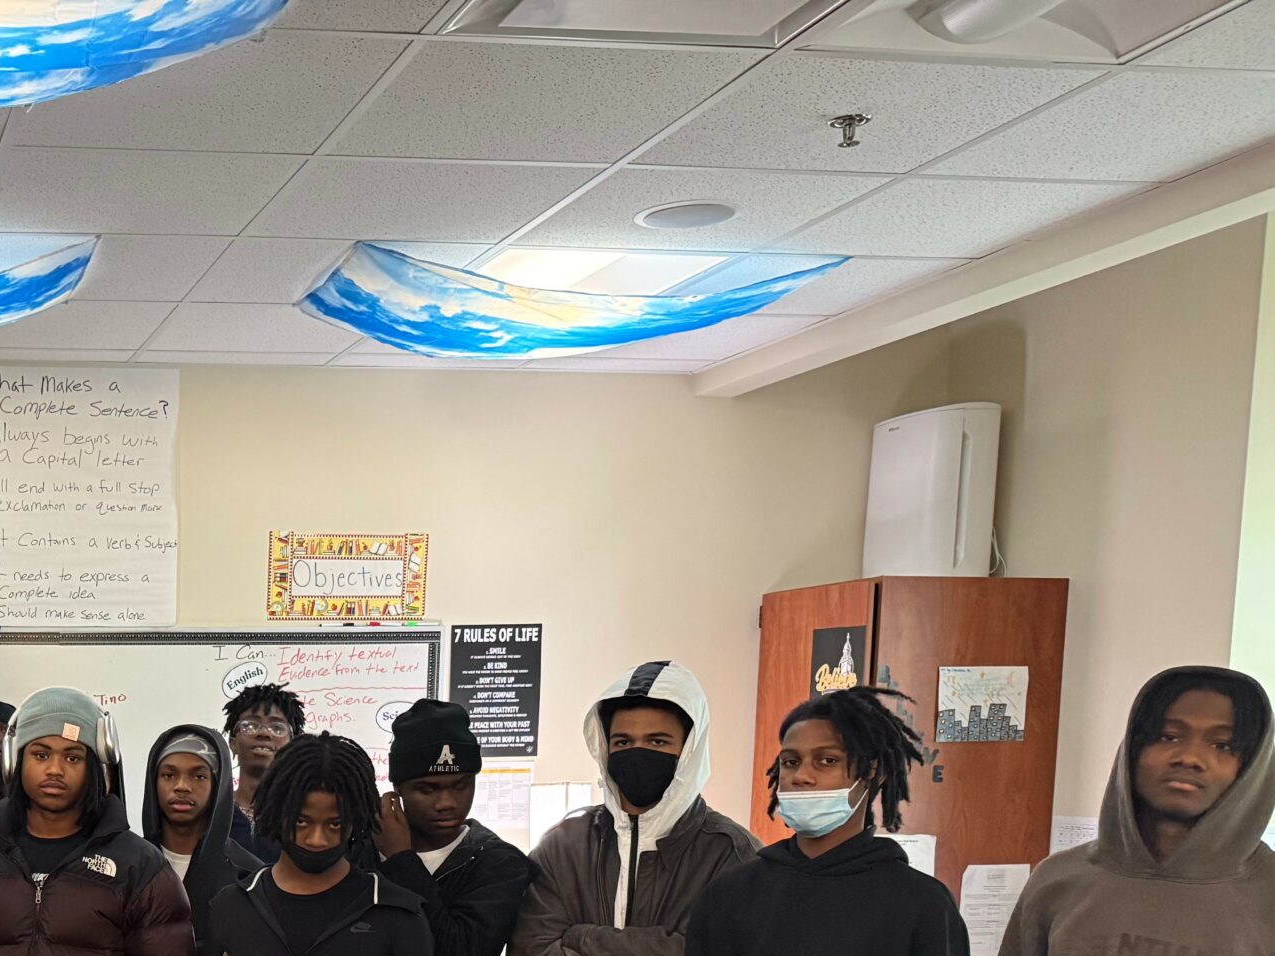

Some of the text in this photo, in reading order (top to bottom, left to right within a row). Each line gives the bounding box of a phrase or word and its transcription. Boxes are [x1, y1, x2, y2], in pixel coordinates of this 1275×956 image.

[108, 381, 121, 392] a
[0, 396, 169, 420] Complete Sentence?
[63, 426, 111, 455] begins
[121, 434, 158, 447] with
[96, 449, 145, 468] letter
[18, 480, 45, 494] end
[53, 481, 80, 493] with
[86, 484, 93, 493] a
[99, 479, 121, 494] full
[75, 502, 86, 511] or
[95, 501, 137, 516] question
[89, 537, 99, 548] a
[13, 570, 50, 581] needs
[58, 567, 73, 581] to
[79, 571, 130, 587] express
[141, 573, 150, 582] a
[292, 559, 403, 595] Objectives
[68, 586, 96, 599] idea
[118, 607, 146, 621] alone
[454, 628, 539, 643] 7 RULES OF LIFE
[212, 645, 229, 661] I
[277, 647, 397, 669] Identify textual
[366, 664, 387, 674] the
[392, 661, 419, 673] text
[226, 666, 264, 691] English
[325, 692, 377, 707] Science
[489, 706, 519, 714] NEGATIVITY
[87, 863, 105, 874] FACE
